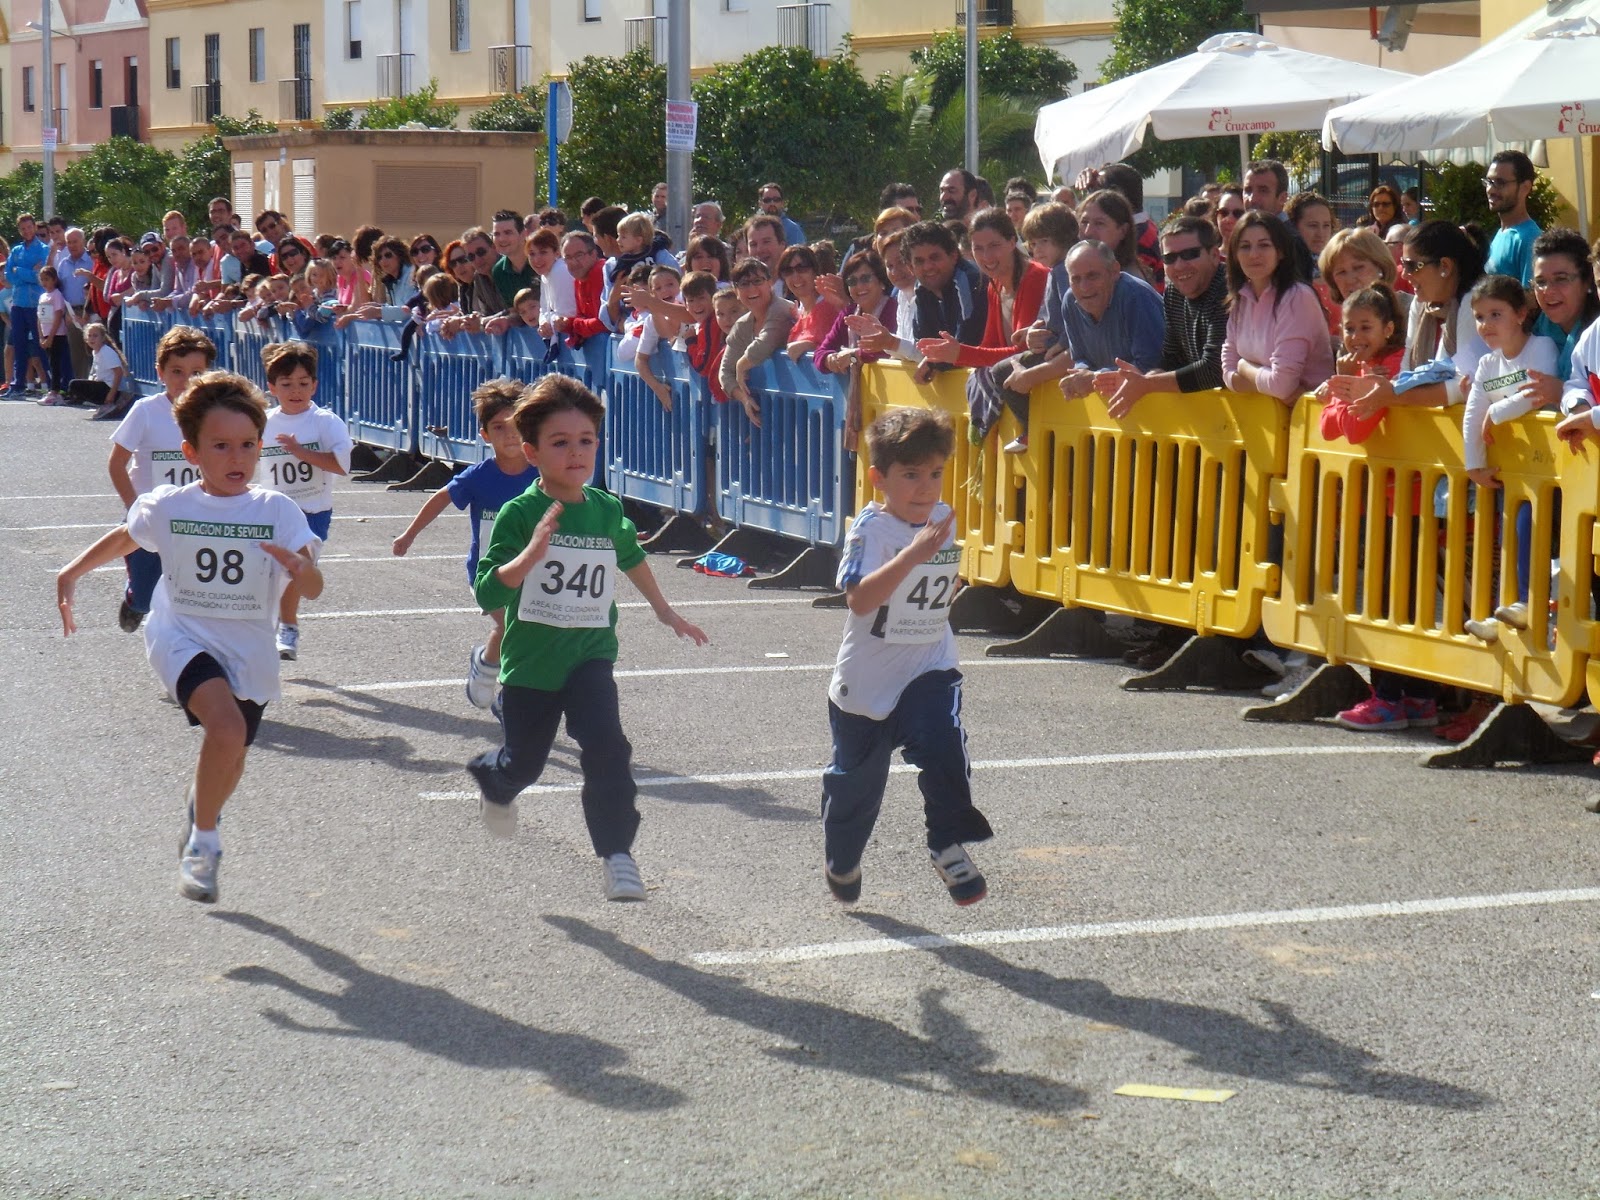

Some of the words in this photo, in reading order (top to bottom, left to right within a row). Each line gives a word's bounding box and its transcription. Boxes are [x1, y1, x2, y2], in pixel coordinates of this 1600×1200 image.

[1225, 120, 1276, 132] Cruzcampo
[270, 460, 313, 485] 109
[172, 521, 221, 536] DIPUTACION
[223, 525, 235, 537] DE
[237, 526, 271, 539] SEVILLA
[549, 533, 586, 548] UTACION
[586, 537, 595, 548] DE
[195, 548, 244, 585] 98
[540, 560, 606, 599] 340
[553, 603, 563, 612] DE
